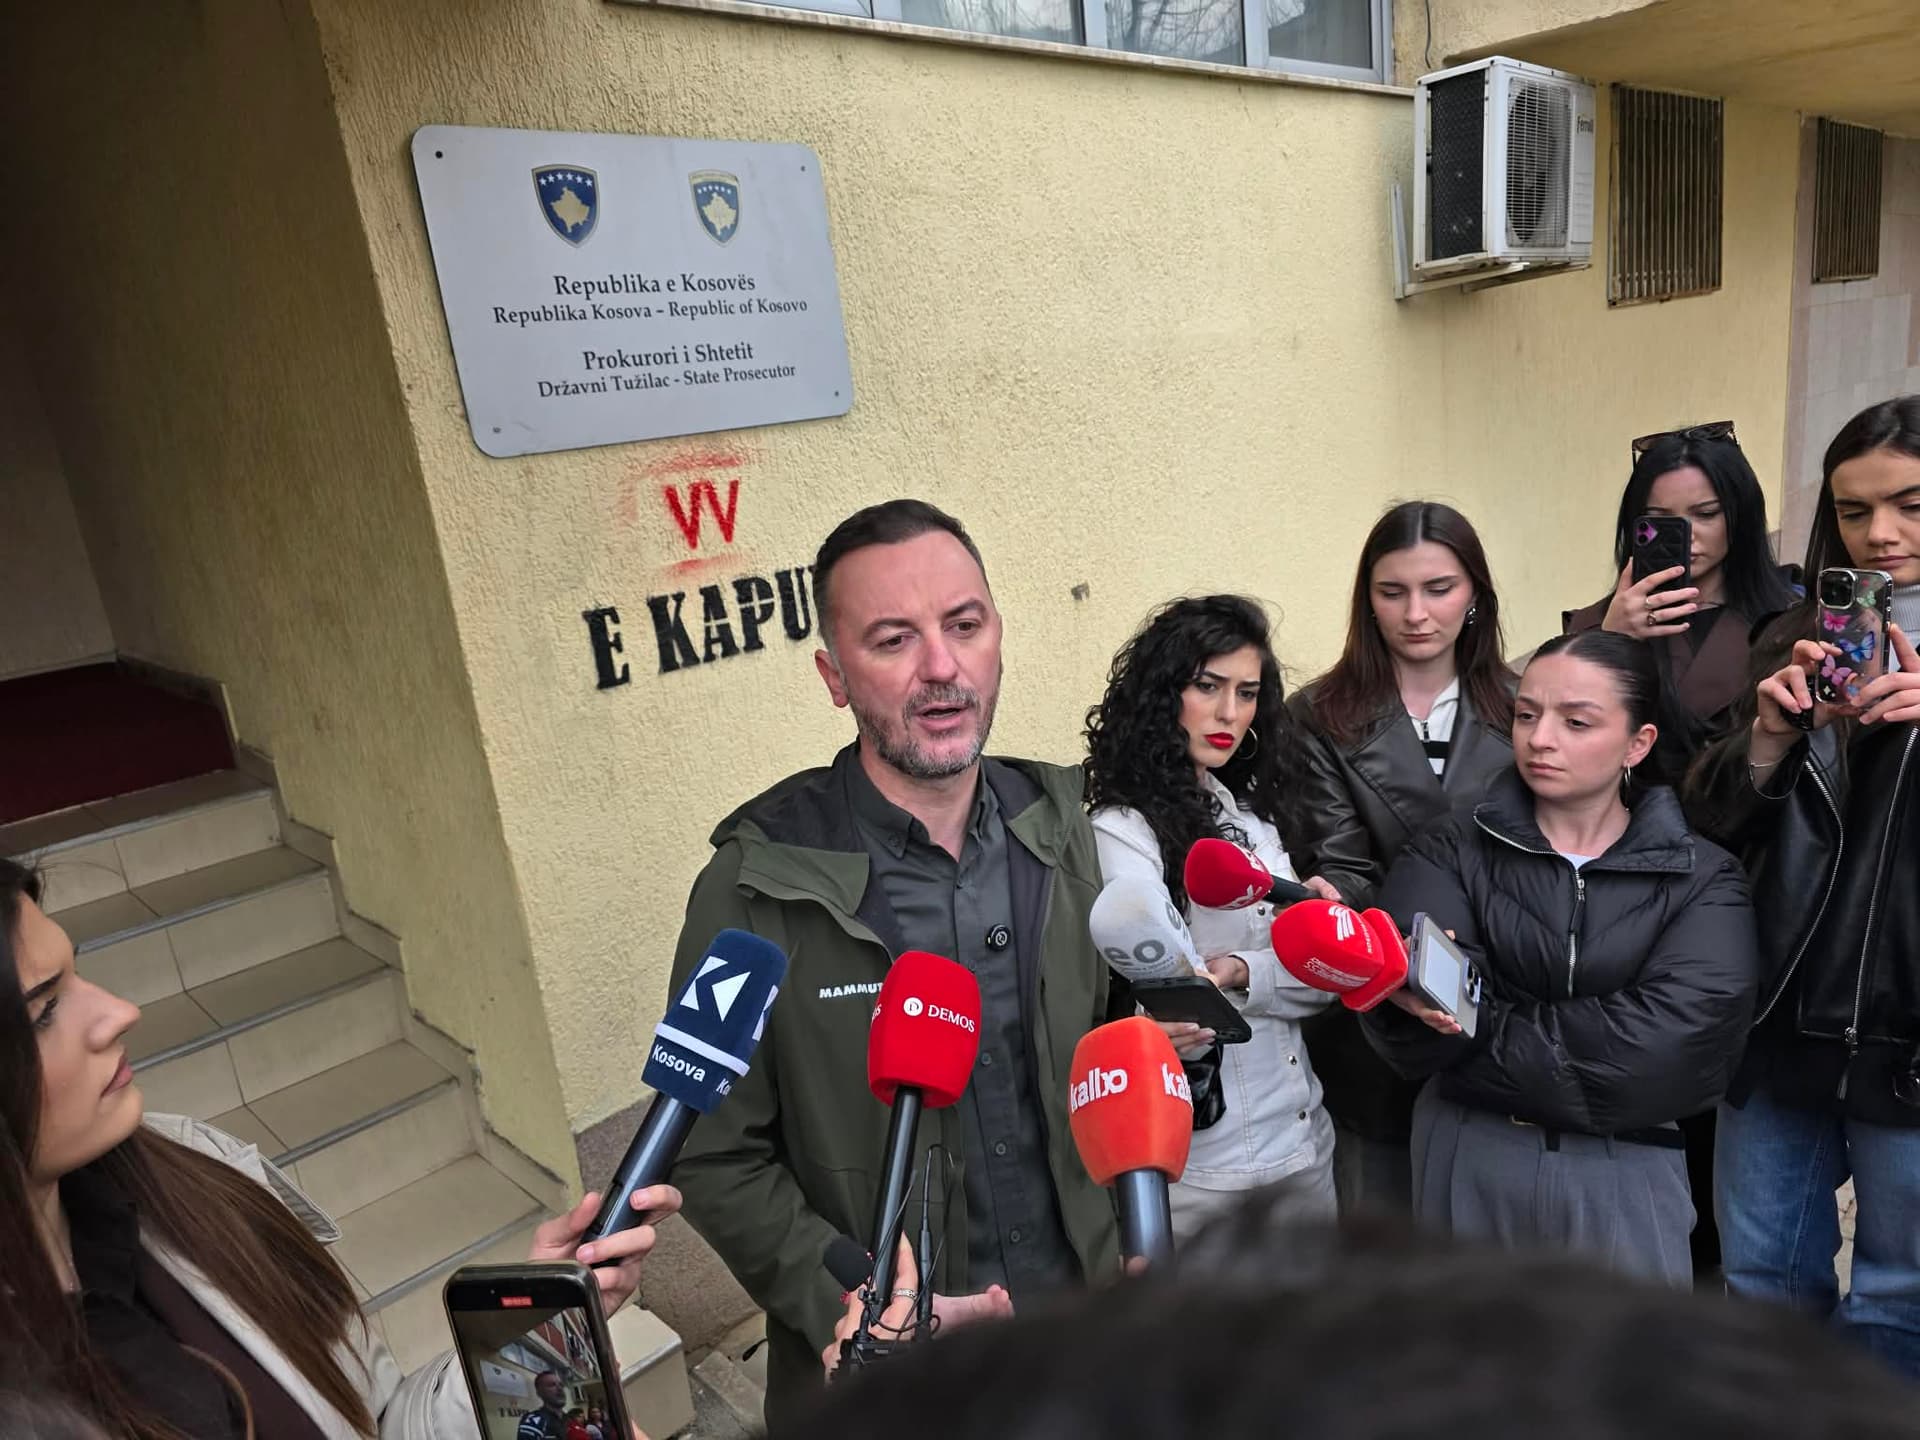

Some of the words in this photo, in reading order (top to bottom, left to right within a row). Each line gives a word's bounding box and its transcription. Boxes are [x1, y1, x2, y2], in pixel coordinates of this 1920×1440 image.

[553, 274, 661, 300] Republika
[666, 278, 676, 292] e
[680, 273, 756, 292] Kosovës
[493, 304, 587, 328] Republika
[591, 303, 652, 320] Kosova
[668, 299, 735, 320] Republic
[739, 298, 753, 314] of
[756, 298, 808, 314] Kosovo
[583, 345, 679, 370] Prokurori
[683, 345, 690, 363] i
[695, 341, 754, 362] Shtetit
[537, 376, 608, 398] Državni
[610, 372, 670, 391] Tužilac
[683, 370, 720, 385] State
[723, 365, 796, 382] Prosecutor
[582, 606, 630, 689] E
[646, 565, 817, 674] KAPU
[928, 1004, 975, 1033] DEMOS
[652, 1044, 706, 1082] Kosova
